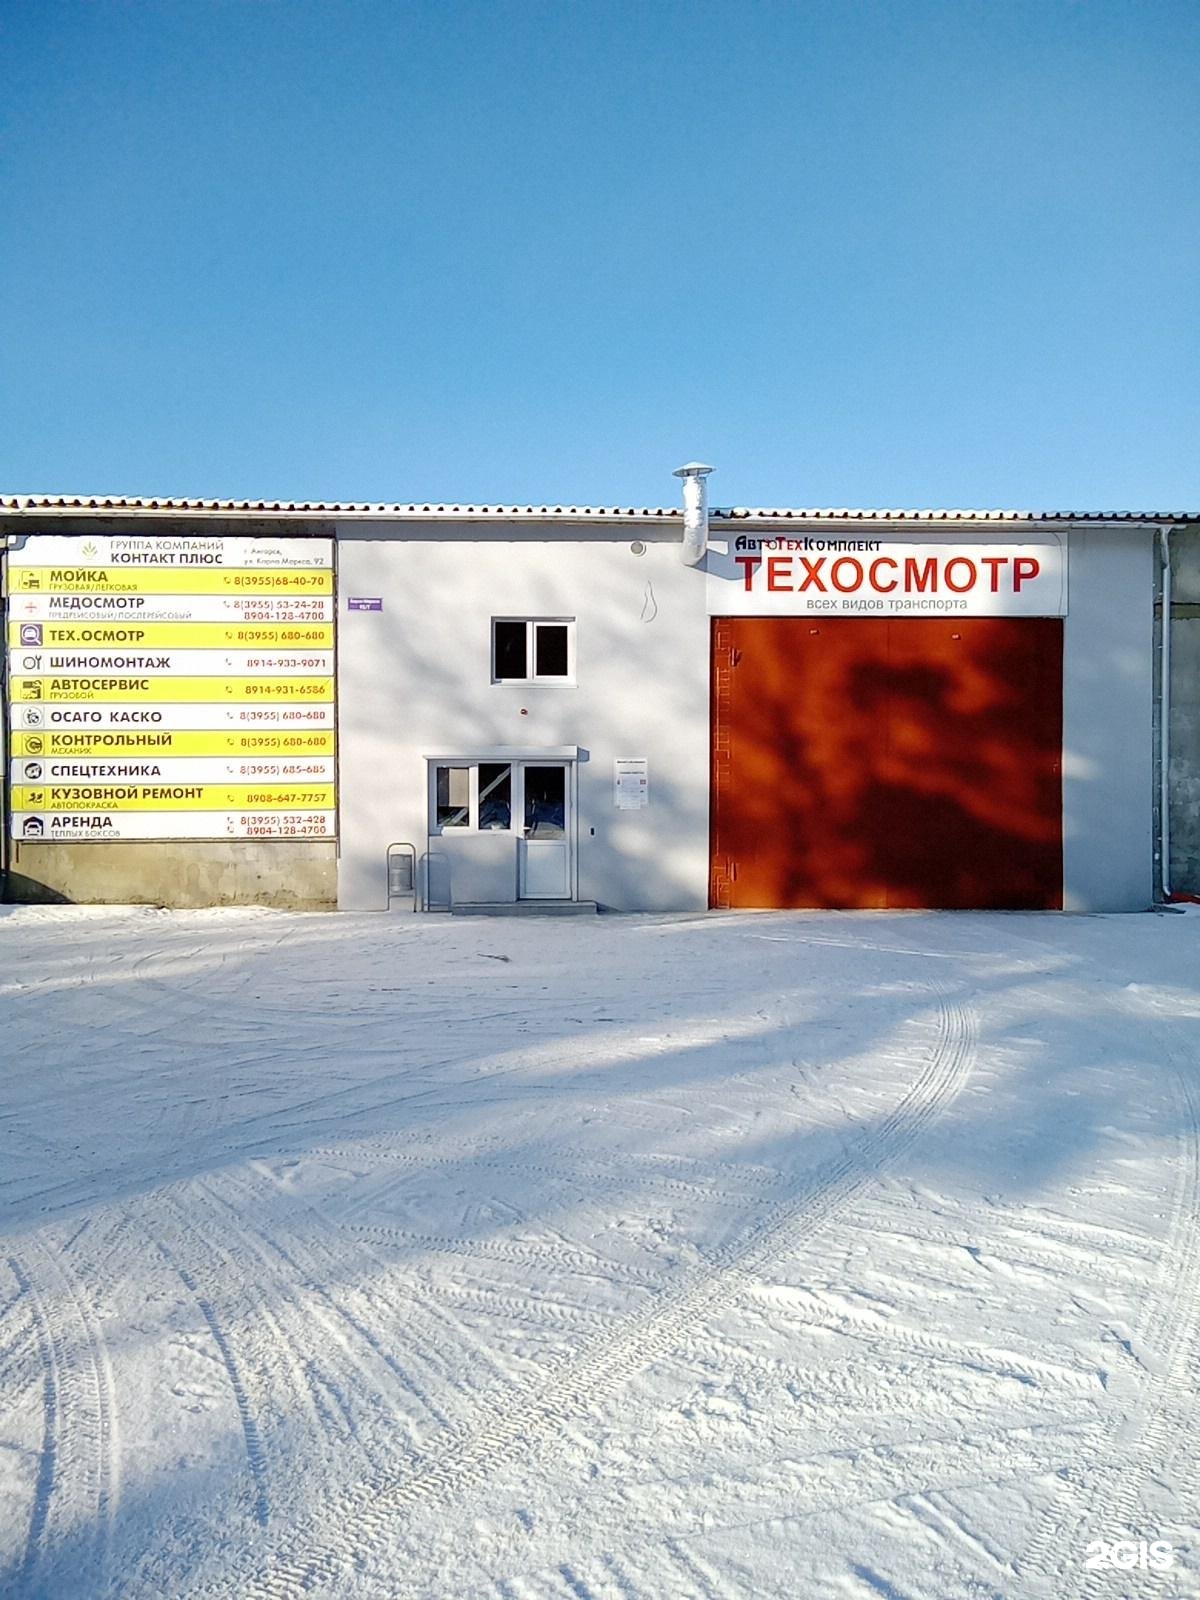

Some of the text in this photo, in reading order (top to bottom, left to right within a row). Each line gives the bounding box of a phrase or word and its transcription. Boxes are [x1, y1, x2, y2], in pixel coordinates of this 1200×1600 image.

[110, 539, 224, 550] ГРУППА КОМПАНИЙ
[111, 553, 223, 564] КОНТАКТ ПЛЮС
[50, 568, 109, 582] МОЙКА
[735, 556, 1040, 593] ТЕХОСМОТР
[48, 583, 138, 592] ГРУЗОВАЯ/ЛЕГКОВАЯ
[49, 597, 145, 609] МЕДОСМОТР
[233, 600, 274, 611] 8(3955)
[807, 599, 968, 612] всех видов транспорта
[49, 630, 145, 641] ТЕХ.ОСМОТР
[237, 631, 278, 641] 8(3955)
[50, 656, 171, 668] ШИНОМОНТАЖ
[50, 679, 150, 690] АВТОСЕРВИС
[50, 691, 94, 699] ГРУЗОВОЙ
[50, 711, 162, 723] ОСАГО КАСКО
[240, 711, 280, 722] 8(3955)
[51, 731, 173, 746] КОНТРОЛЬНЫЙ
[240, 737, 281, 748] 8(3955)
[51, 765, 161, 778] СПЕЦТЕХНИКА
[240, 765, 280, 776] 8(3955)
[51, 785, 204, 799] КУЗОВНОЙ РЕМОНТ
[50, 801, 119, 810] АВТОПОКРАСКА
[51, 816, 113, 829] АРЕНДА
[240, 816, 280, 826] 8(3955)
[51, 830, 121, 838] ТЕПЛЫХ БОКСОВ
